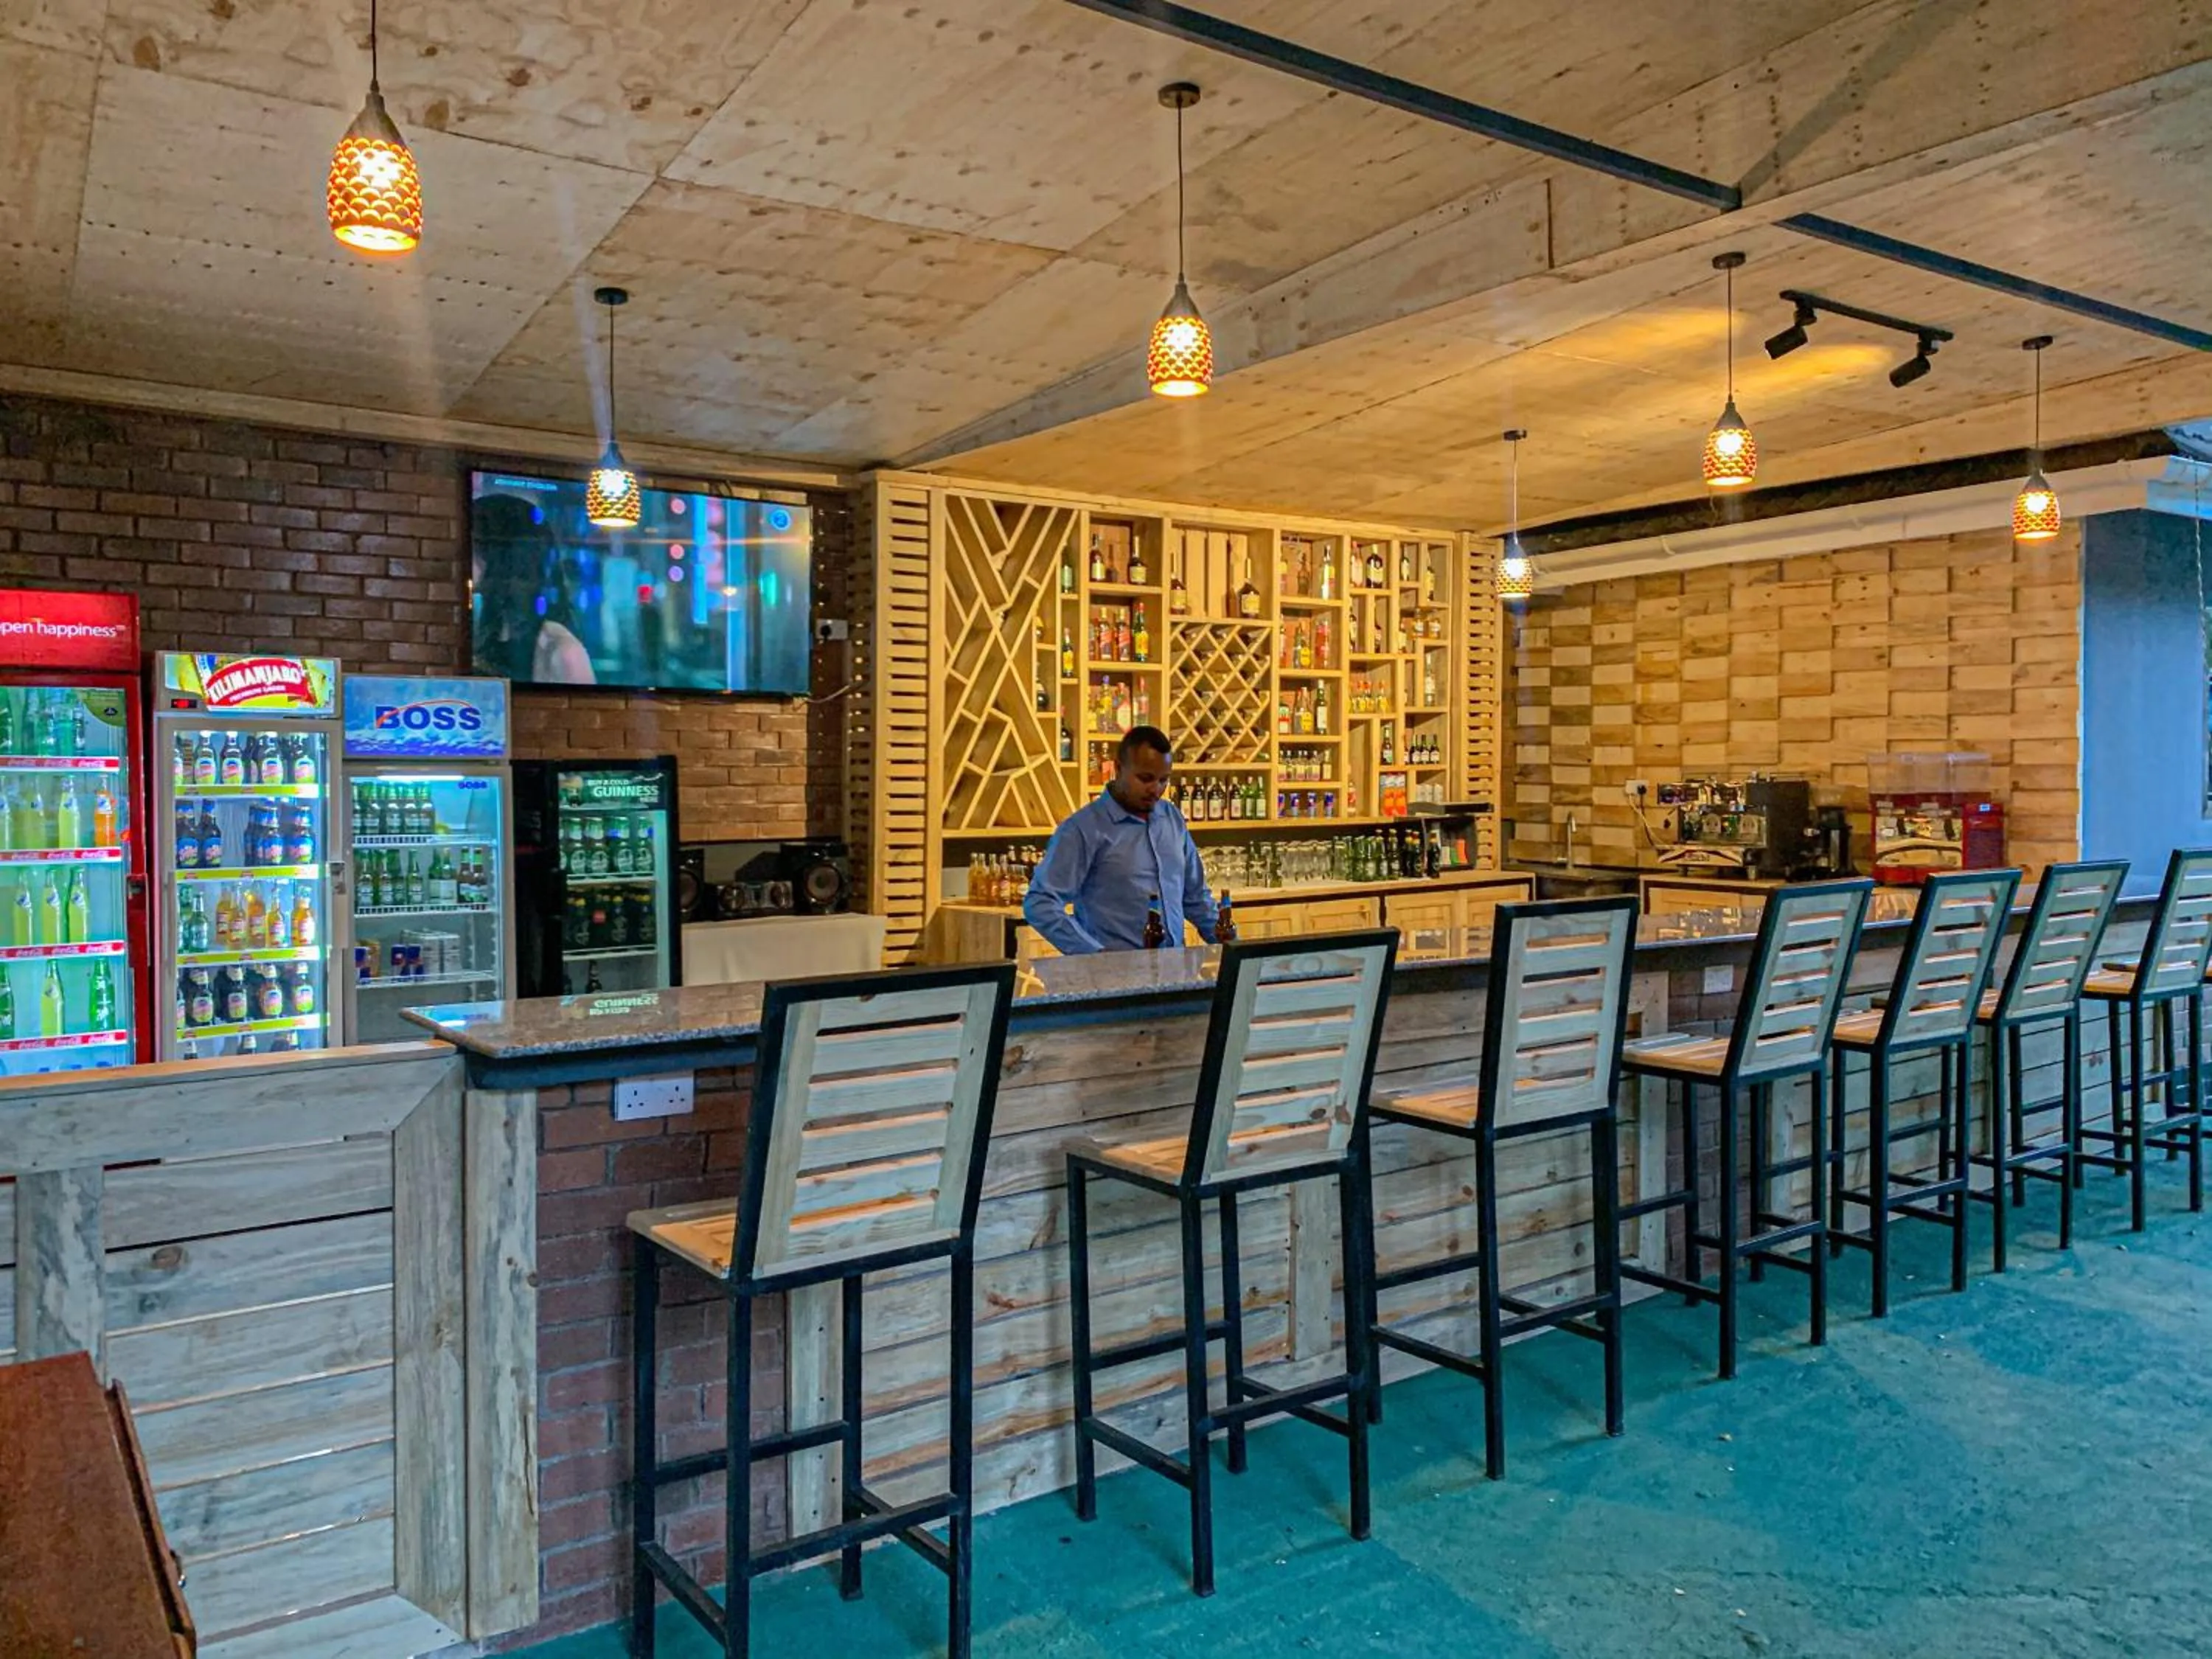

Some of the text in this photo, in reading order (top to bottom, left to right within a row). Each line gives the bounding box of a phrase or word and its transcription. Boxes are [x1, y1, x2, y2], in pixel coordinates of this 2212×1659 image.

[0, 622, 33, 636] pen
[207, 665, 302, 703] KILIMANJARO
[375, 706, 481, 730] BOSS
[593, 785, 658, 797] GUINNESS
